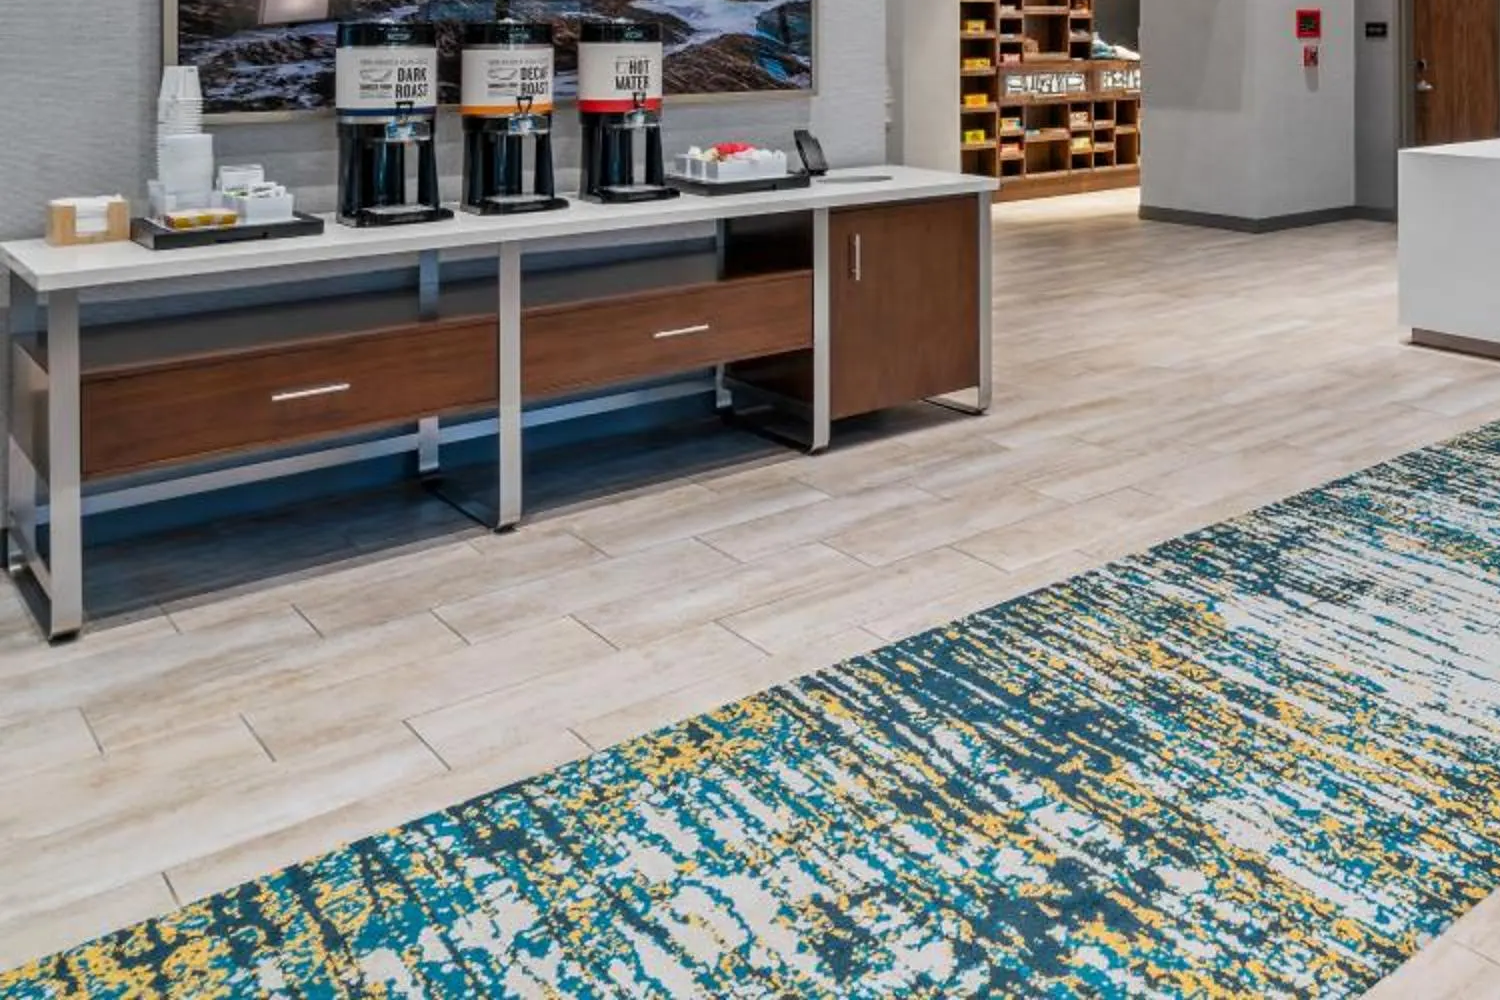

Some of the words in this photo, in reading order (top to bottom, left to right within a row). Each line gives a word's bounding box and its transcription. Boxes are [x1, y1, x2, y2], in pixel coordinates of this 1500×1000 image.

[628, 58, 651, 75] HOT
[397, 67, 428, 83] DARK
[615, 75, 650, 90] WATER
[395, 83, 429, 99] ROAST
